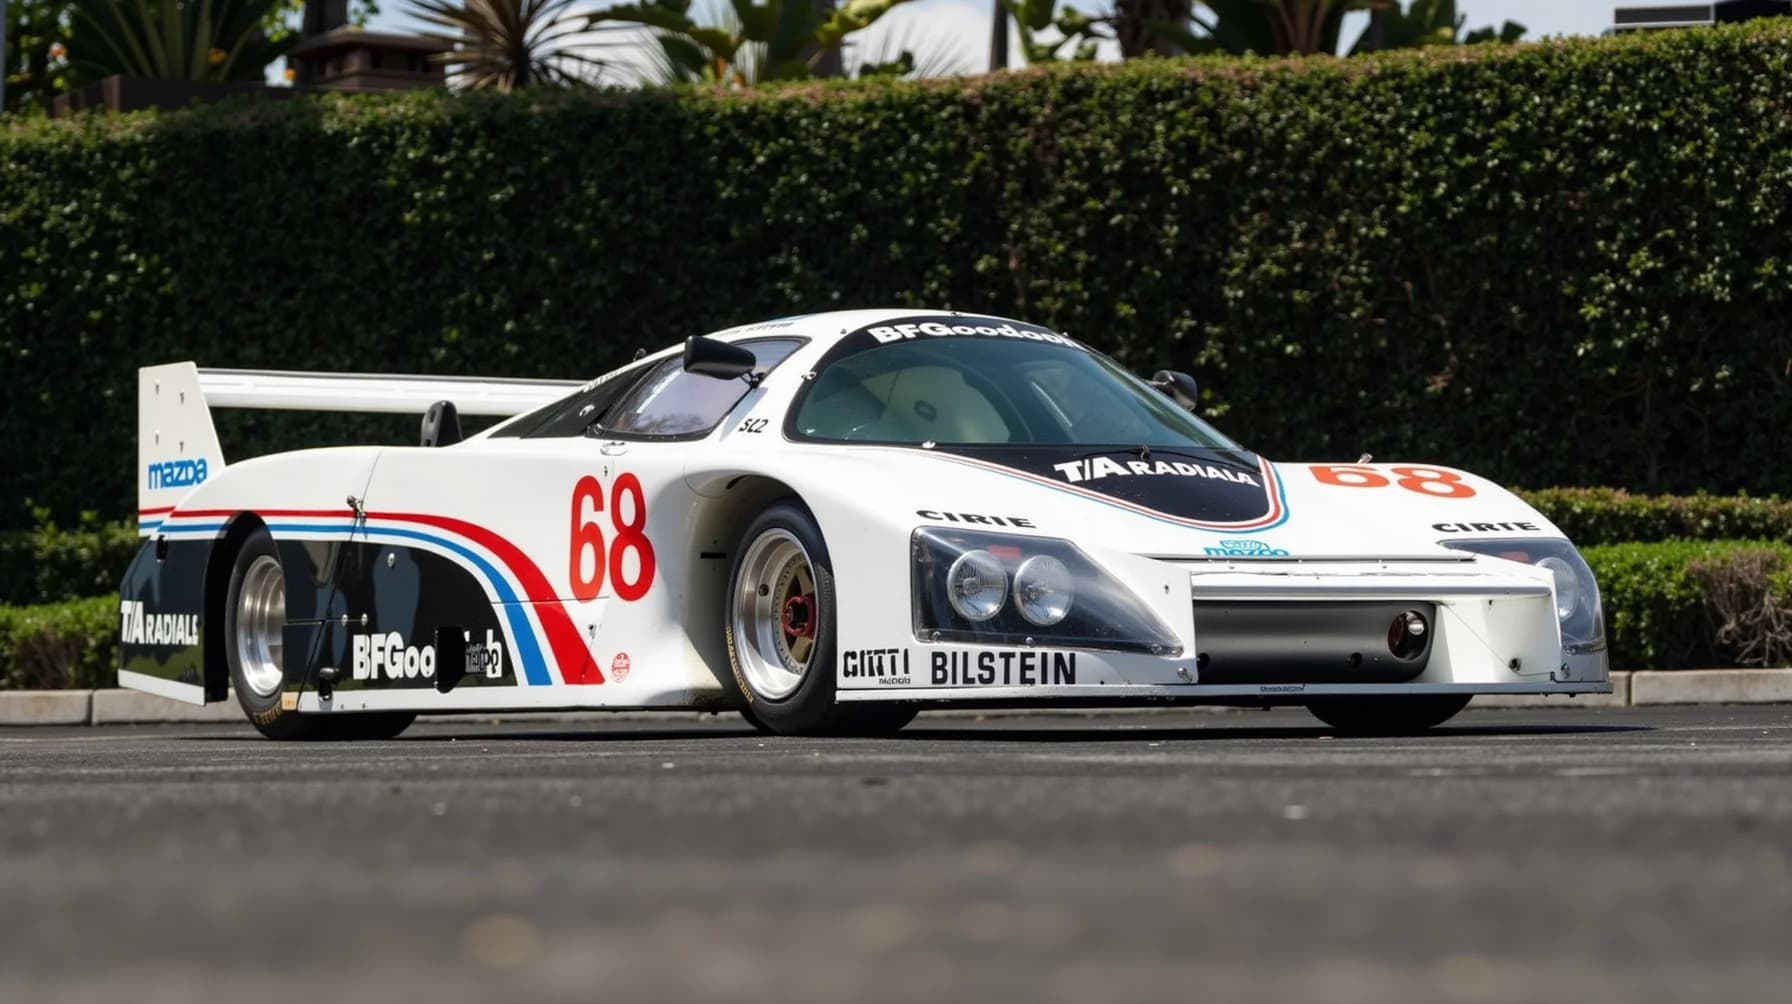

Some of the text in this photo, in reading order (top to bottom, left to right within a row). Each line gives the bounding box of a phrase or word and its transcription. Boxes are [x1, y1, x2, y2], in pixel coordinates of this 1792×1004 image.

[1309, 465, 1477, 498] 68
[569, 472, 656, 603] 68
[931, 651, 1077, 685] BILSTEIN
